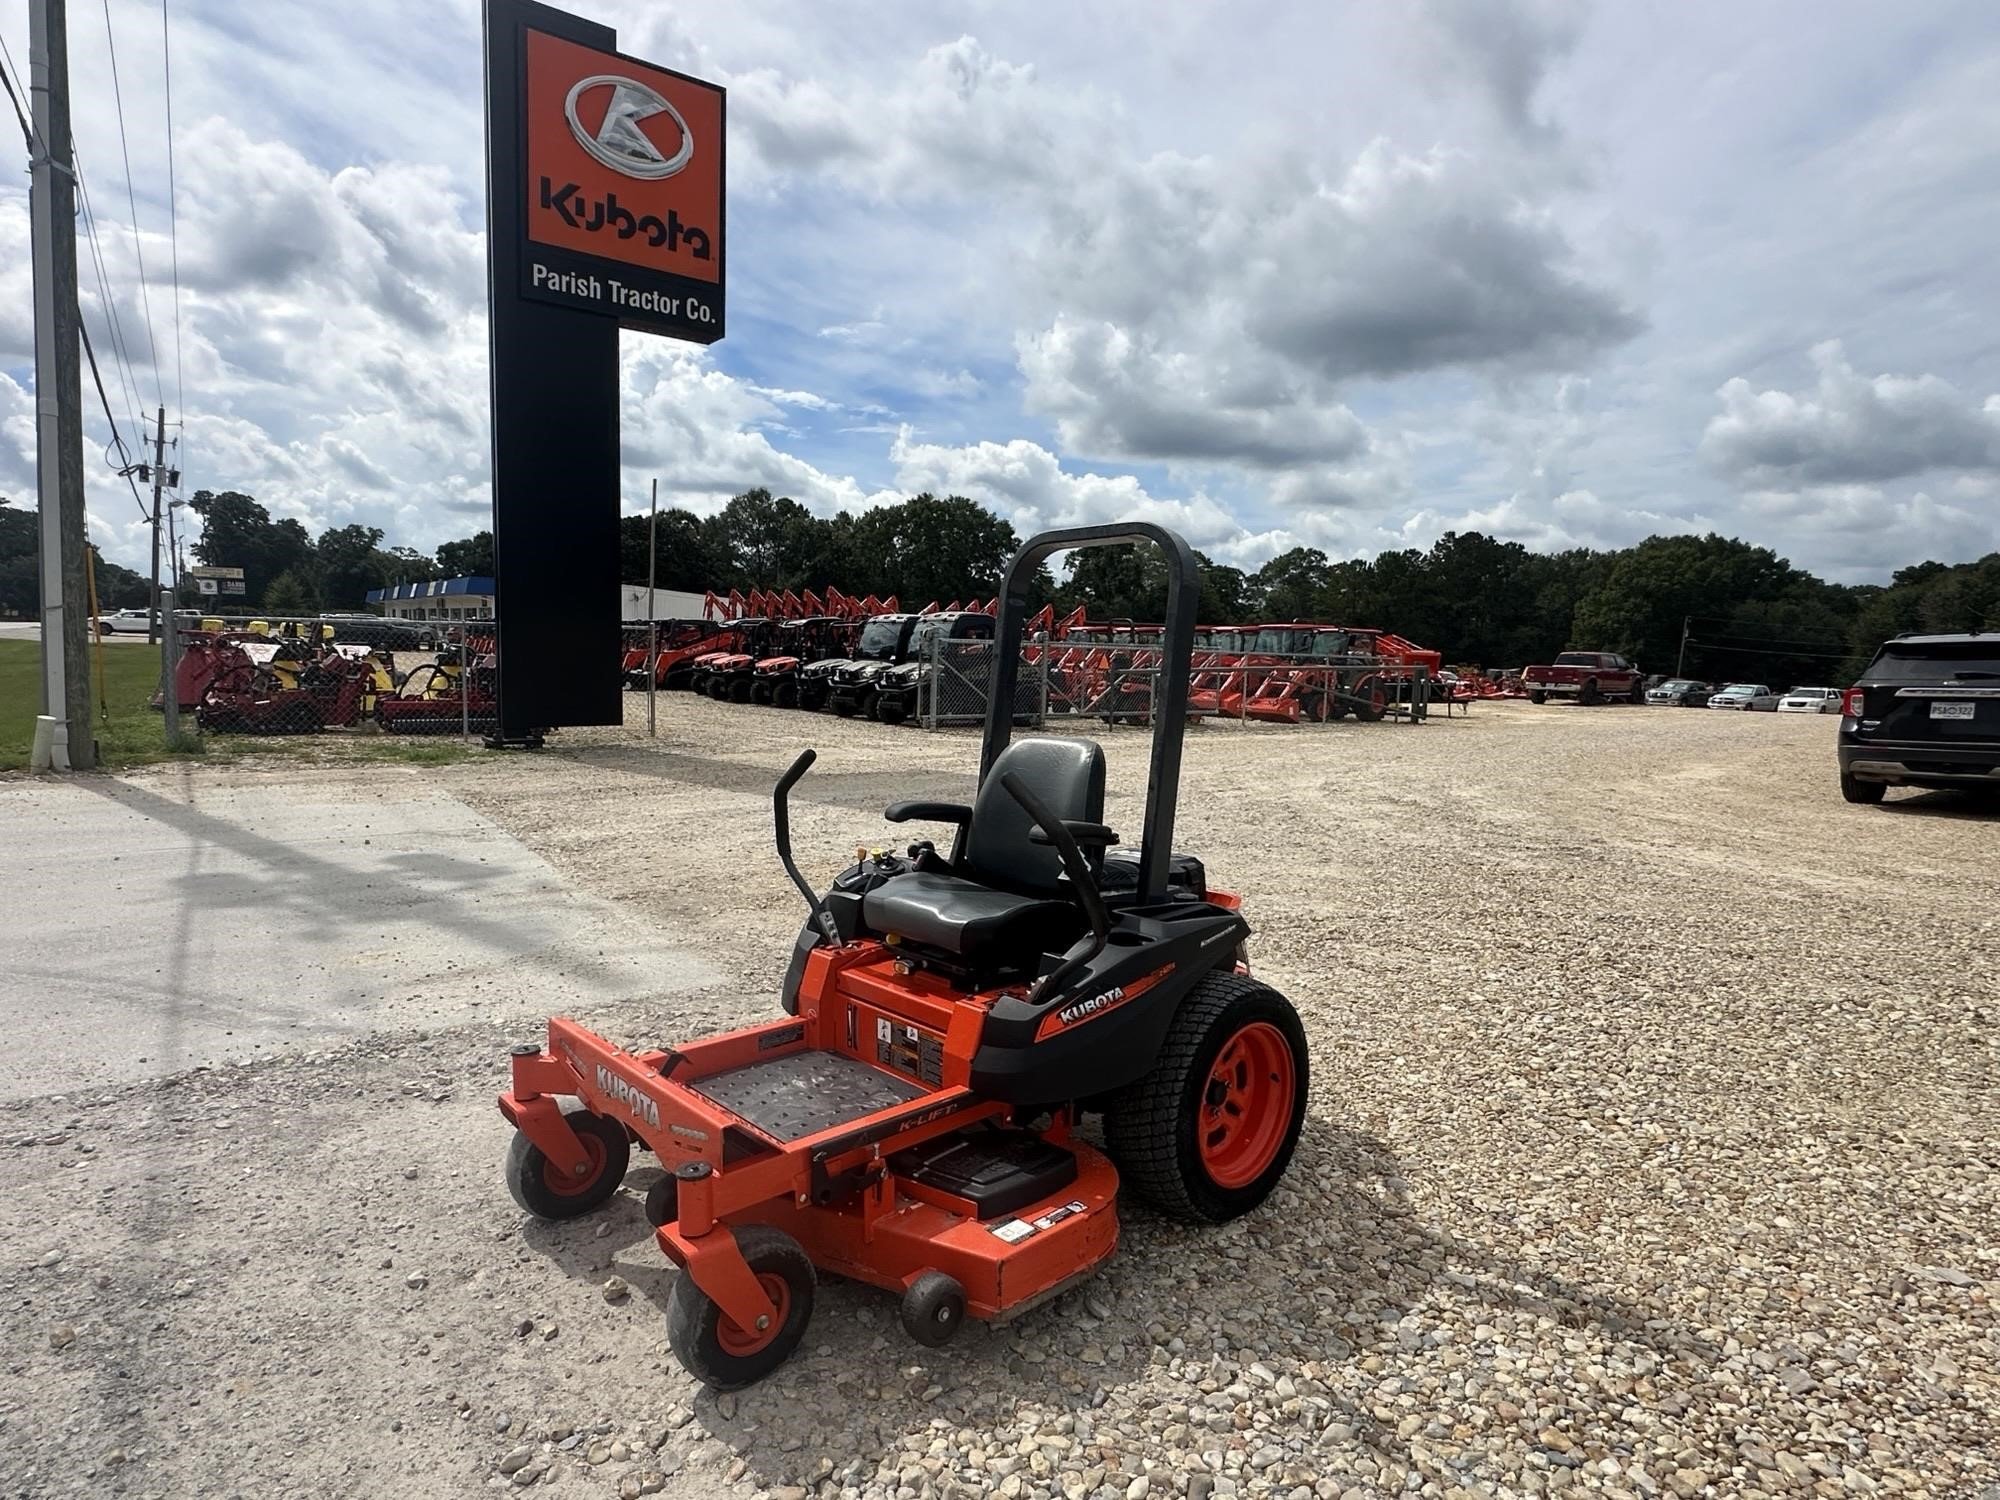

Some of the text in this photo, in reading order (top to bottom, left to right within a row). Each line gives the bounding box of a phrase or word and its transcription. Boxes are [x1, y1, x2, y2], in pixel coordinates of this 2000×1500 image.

[540, 176, 711, 261] Kubota
[532, 263, 716, 323] Parish Tractor Co.
[1060, 987, 1125, 1025] KUBOTA
[596, 1064, 662, 1132] KUBOTA
